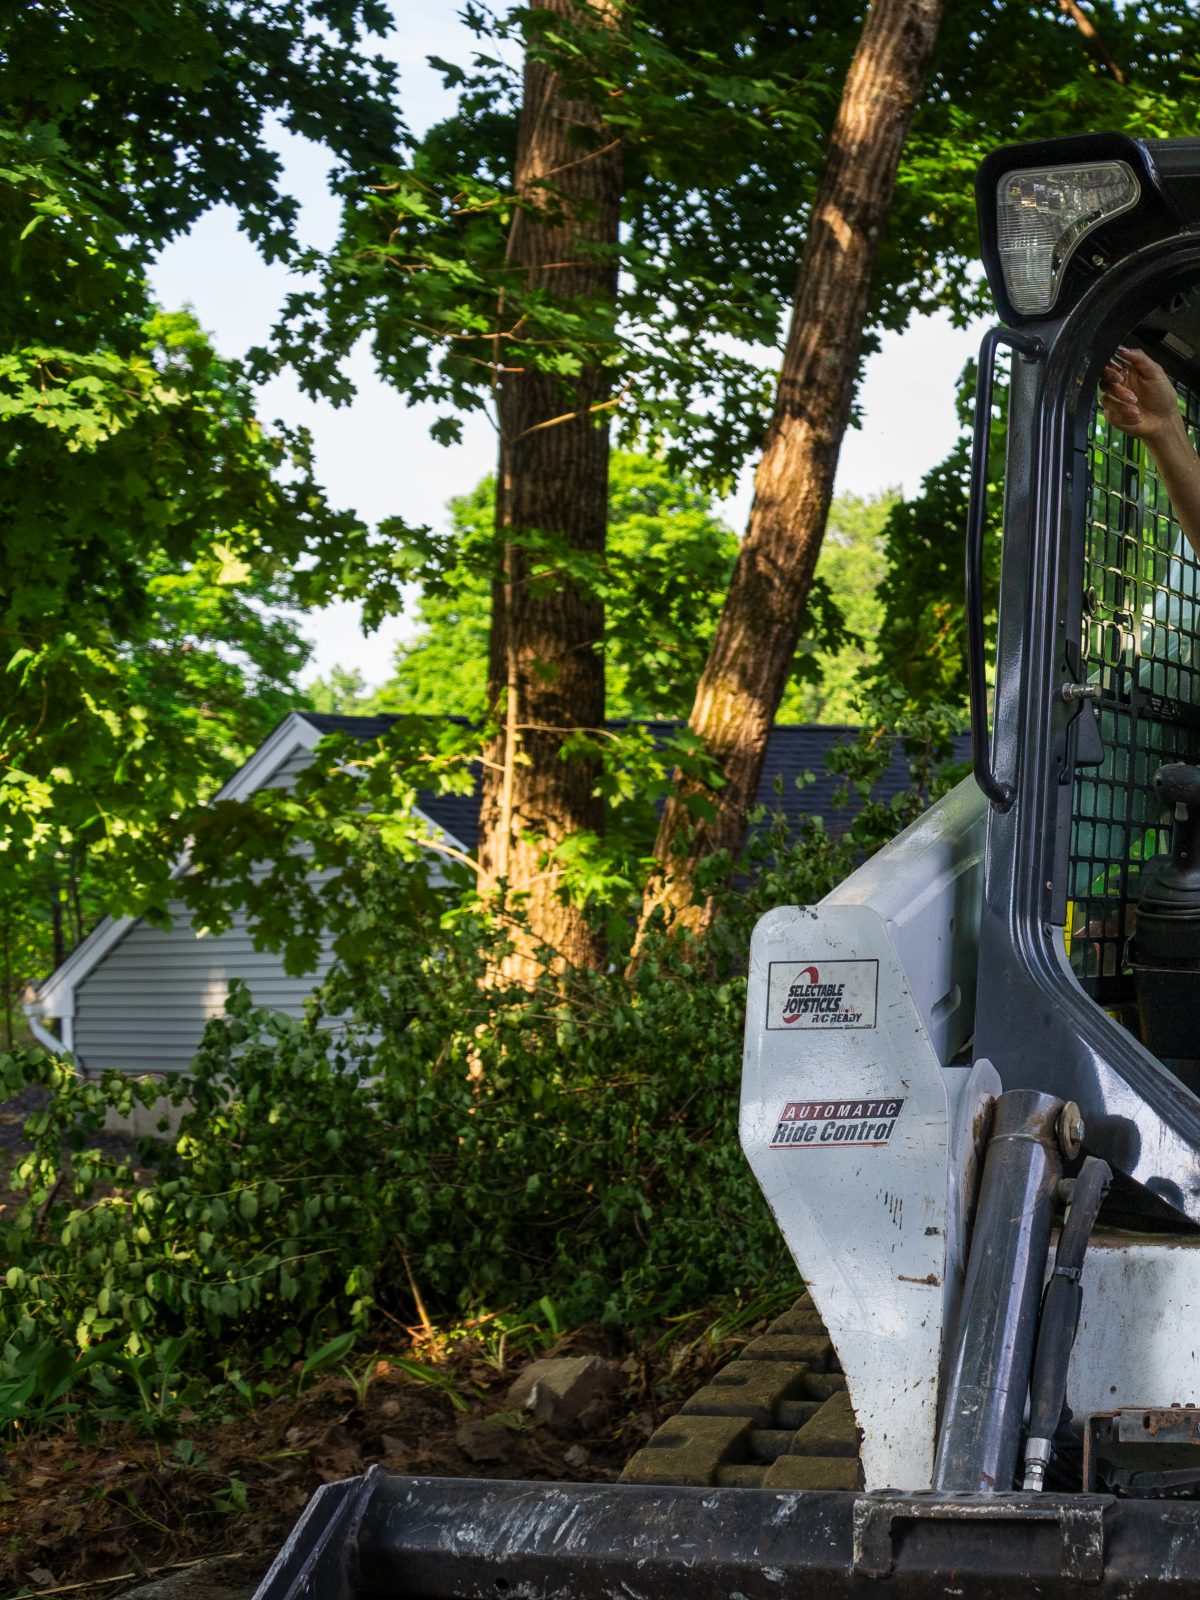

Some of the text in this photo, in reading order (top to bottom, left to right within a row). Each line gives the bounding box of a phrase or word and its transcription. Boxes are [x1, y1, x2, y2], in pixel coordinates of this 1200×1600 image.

[788, 984, 845, 998] SELECTABLE
[782, 998, 842, 1014] JOYSTICKS
[829, 1013, 863, 1023] READY
[785, 1102, 897, 1119] AUTOMATIC
[772, 1118, 897, 1144] Ride Control
